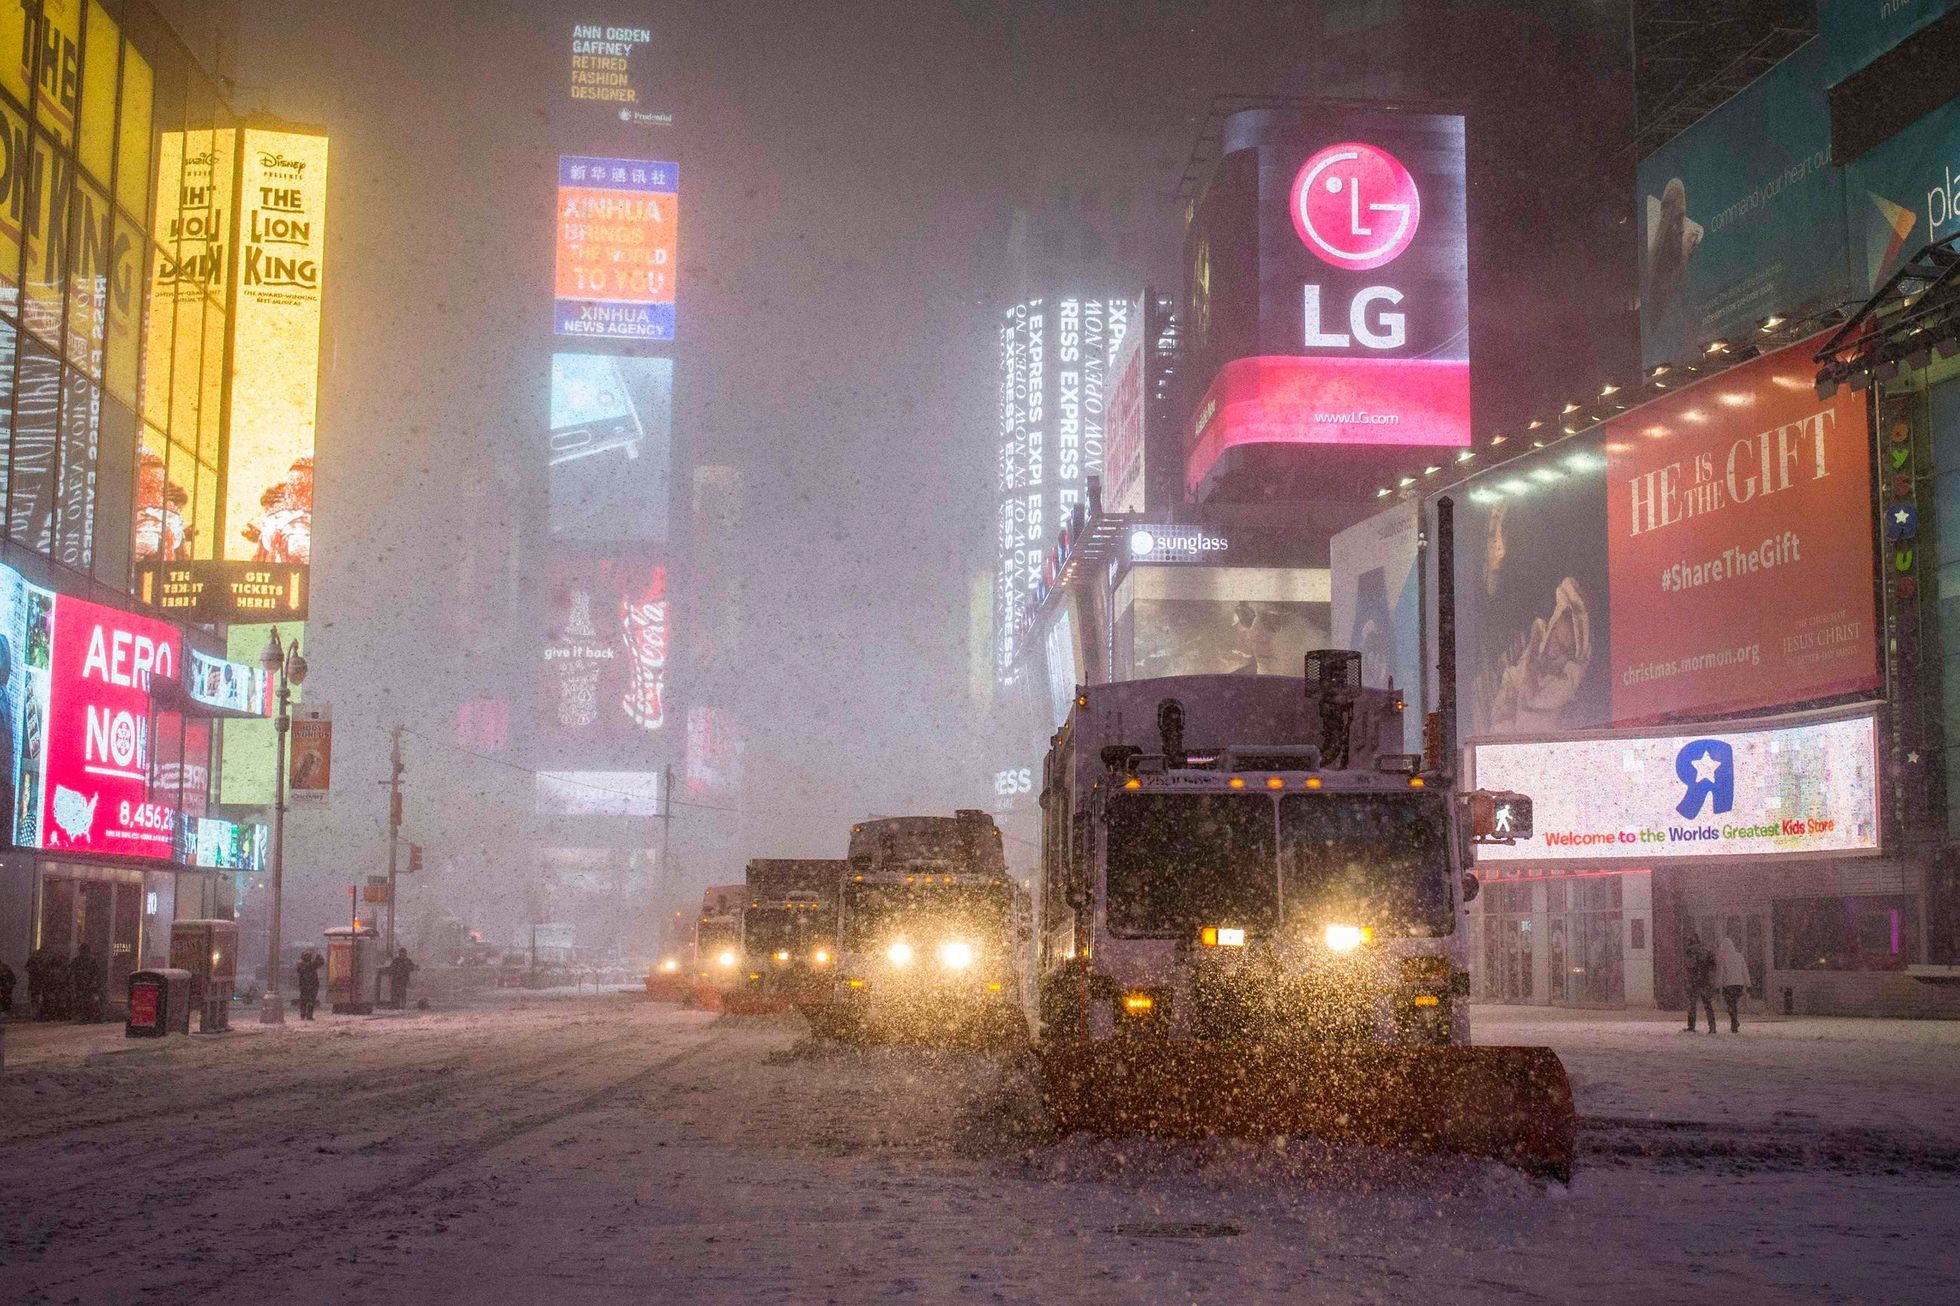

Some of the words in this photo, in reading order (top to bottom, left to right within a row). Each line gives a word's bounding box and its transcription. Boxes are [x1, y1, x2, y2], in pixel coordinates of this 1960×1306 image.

[572, 40, 632, 56] GAFFNEY
[573, 25, 601, 39] ANN
[606, 27, 650, 43] OGDEN
[571, 71, 628, 86] FASHION
[572, 56, 627, 71] RETIRED
[634, 112, 672, 122] Prudential
[257, 151, 306, 174] Disney
[260, 187, 302, 208] THE
[250, 209, 310, 243] LION
[244, 245, 316, 286] KING
[572, 266, 607, 291] TO
[564, 320, 604, 333] NEWS
[607, 322, 666, 336] AGENCY
[580, 305, 650, 323] XINHUA
[1060, 298, 1079, 362] RESS
[1304, 284, 1406, 349] LG
[1006, 327, 1015, 433] EXPRESS
[1016, 342, 1027, 400] OPEN
[1029, 314, 1043, 424] EXPRESS
[1085, 354, 1104, 415] OPEN
[1016, 405, 1027, 457] NOW
[1060, 371, 1079, 480] EXPRESS
[1314, 411, 1400, 426] www.LG.com
[1085, 416, 1104, 473] NOW
[1726, 408, 1836, 504] GIFT
[1694, 452, 1713, 484] IS
[1629, 462, 1683, 537] HE
[1685, 479, 1726, 518] THE
[1157, 532, 1229, 554] sunglass
[245, 572, 271, 584] GET
[1661, 531, 1801, 592] #ShareTheGift
[231, 583, 284, 596] TICKETS
[237, 596, 276, 609] HERE!
[1004, 559, 1014, 668] EXPRESS
[544, 647, 570, 660] give
[573, 645, 583, 658] it
[585, 646, 614, 659] back
[1783, 631, 1814, 657] JESUS
[1817, 622, 1862, 646] CHRIST
[82, 624, 172, 691] AERO
[1622, 643, 1760, 686] christmas.mormon.org
[1545, 831, 1616, 847] Welcome
[1618, 831, 1637, 844] to
[1640, 828, 1666, 843] the
[1669, 826, 1719, 842] Worlds
[1722, 822, 1780, 840] Greatest
[1782, 818, 1806, 836] Kids
[1807, 817, 1835, 834] Store
